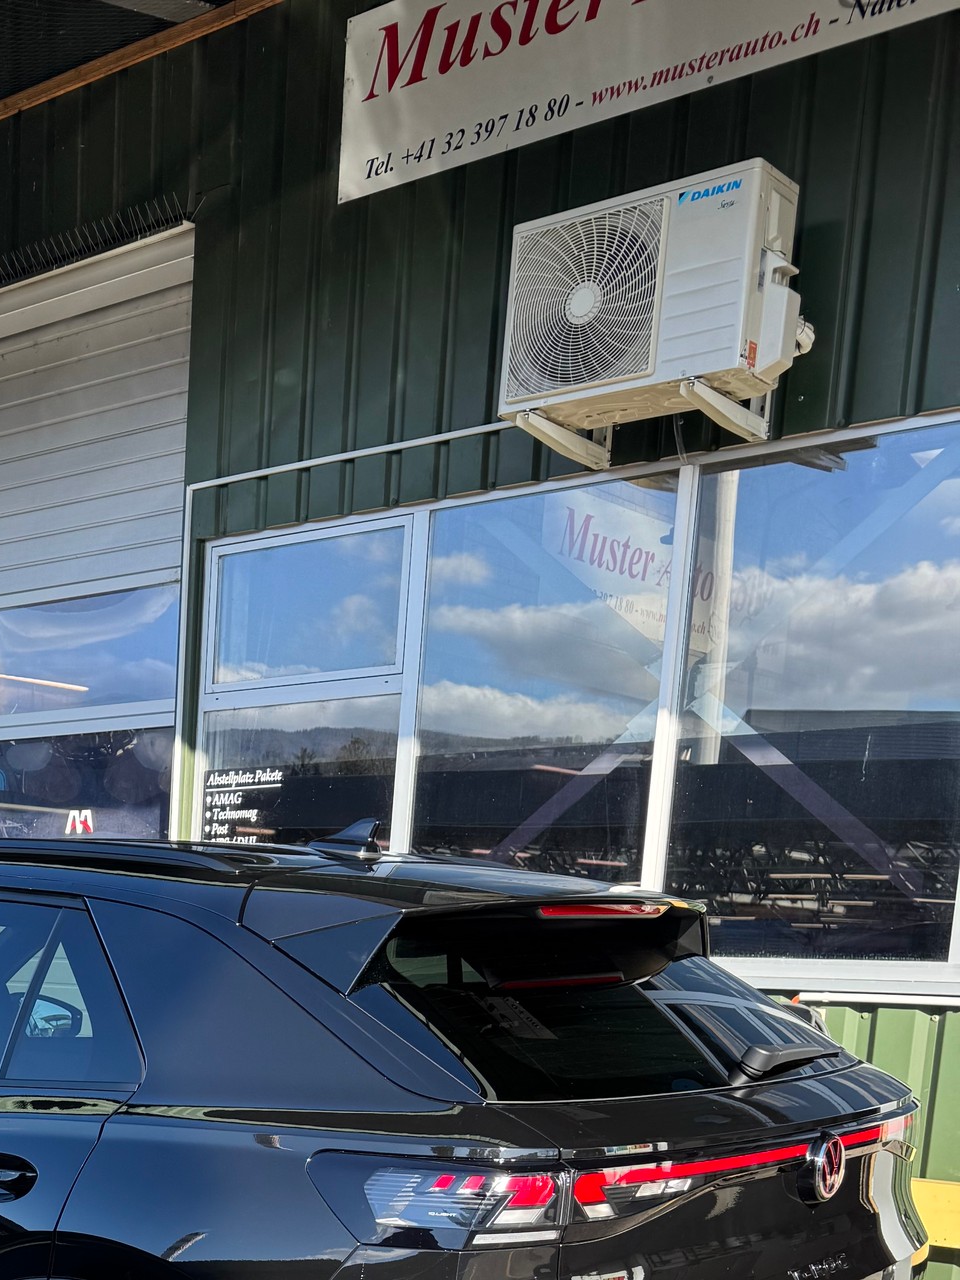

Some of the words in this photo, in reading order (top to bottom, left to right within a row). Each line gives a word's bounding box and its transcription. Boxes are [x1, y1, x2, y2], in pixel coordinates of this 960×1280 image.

[365, 153, 394, 180] Tel.
[401, 138, 436, 166] +41
[441, 128, 466, 155] 32
[470, 113, 509, 146] 397
[513, 104, 538, 132] 18
[544, 93, 570, 121] 80
[591, 12, 821, 107] www.musterauto.ch
[690, 178, 743, 202] DAIKIN
[557, 505, 656, 583] Muster
[206, 770, 254, 788] Abstellplatz
[211, 791, 243, 806] AMAG
[212, 806, 258, 823] Technomag
[210, 822, 229, 835] Post
